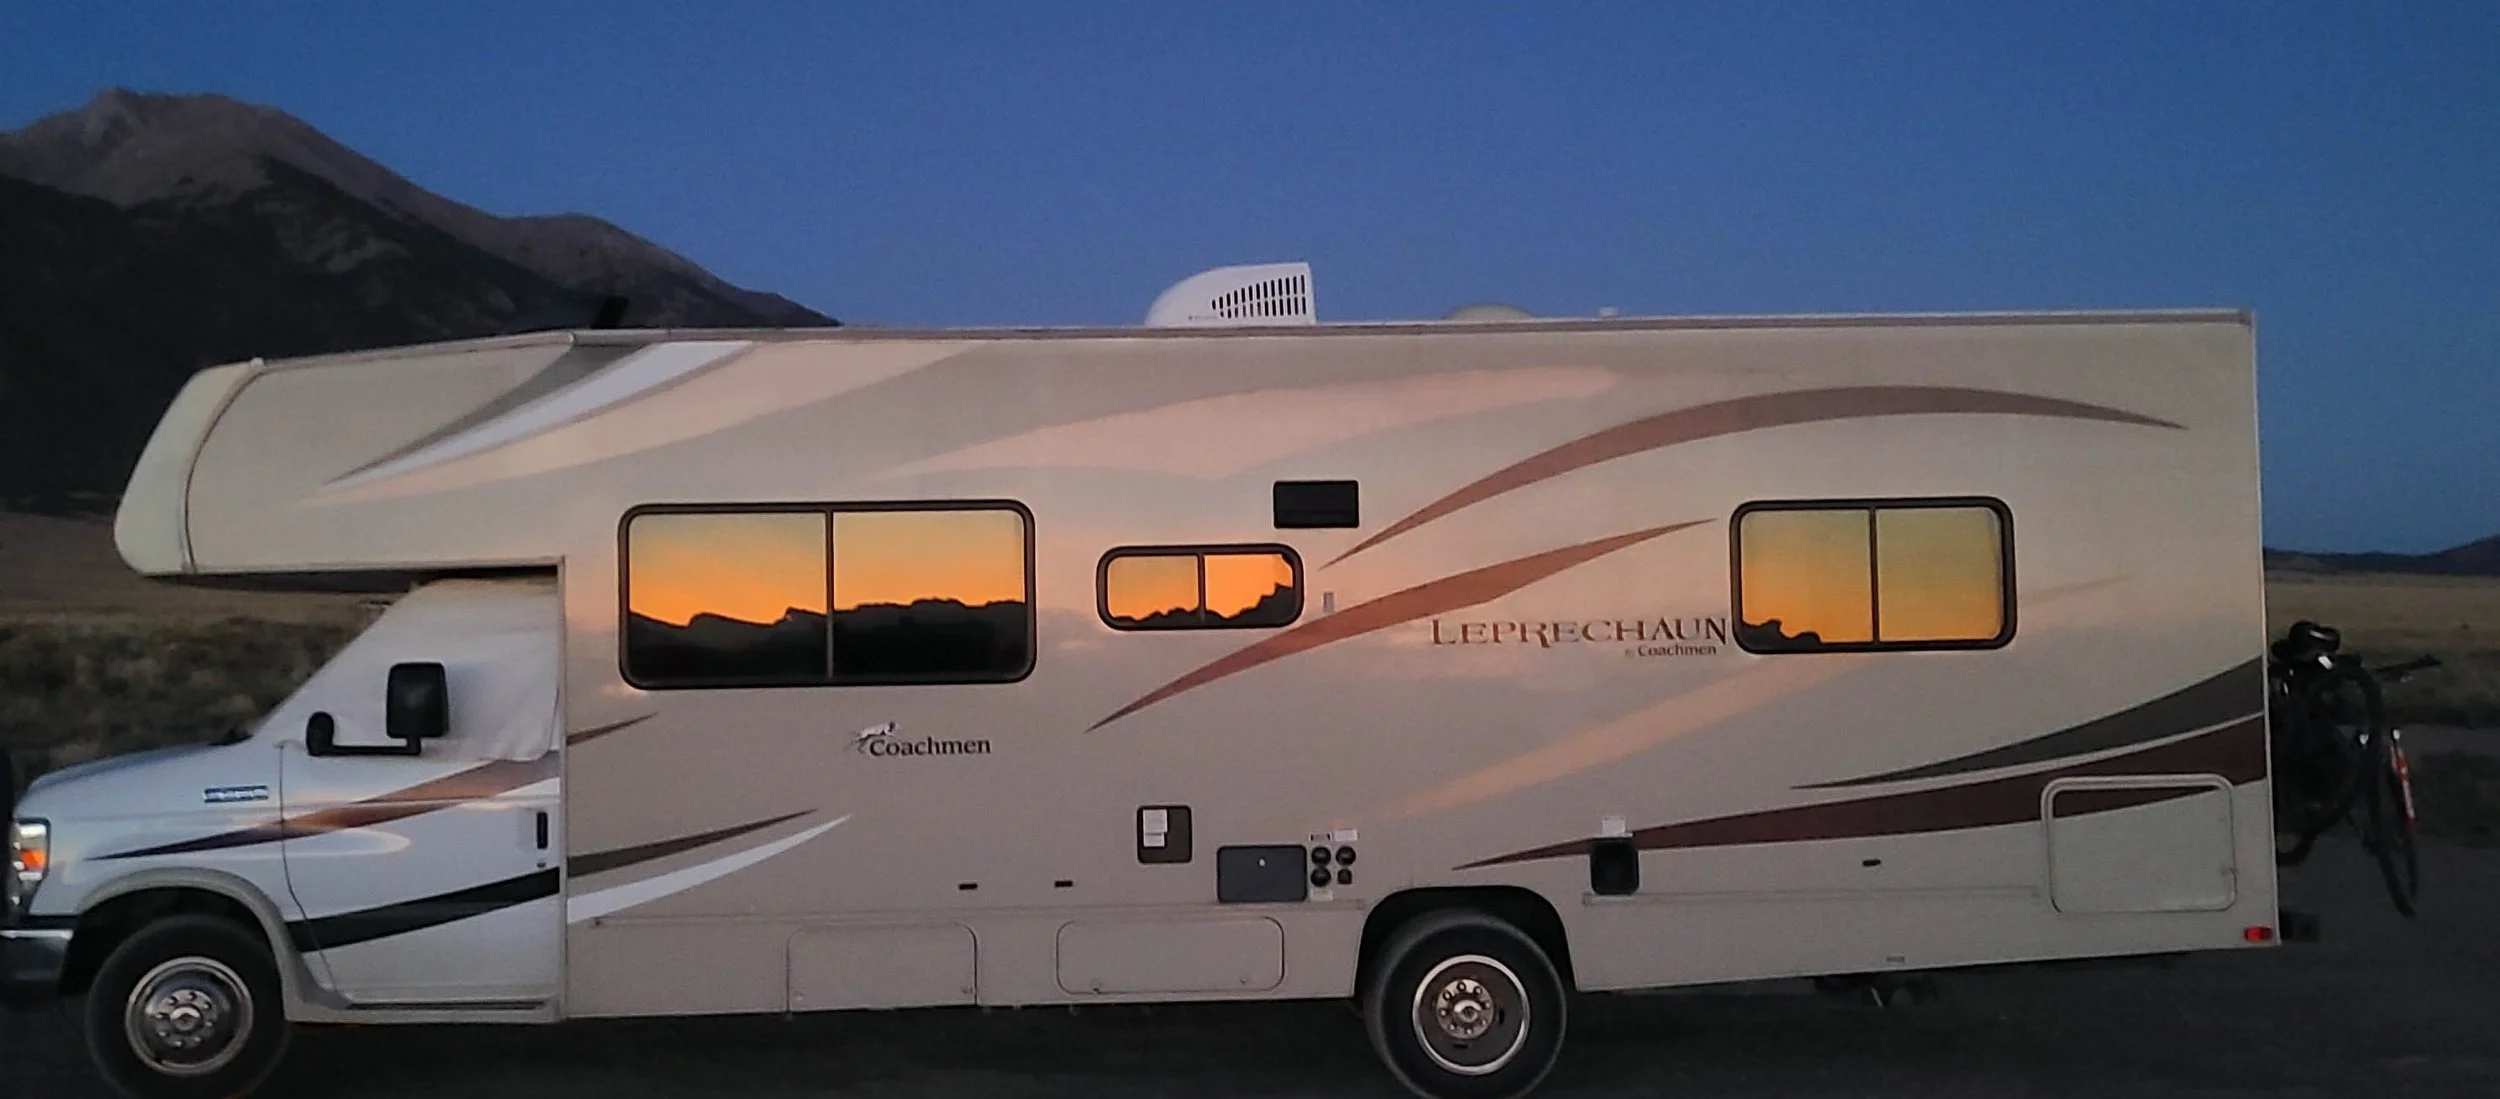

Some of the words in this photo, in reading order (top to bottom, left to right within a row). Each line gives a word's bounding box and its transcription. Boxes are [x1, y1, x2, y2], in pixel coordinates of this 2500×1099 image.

[1431, 617, 1727, 648] LEPRECHAUN
[1637, 644, 1717, 657] Coachmen
[869, 736, 991, 757] Coachmen
